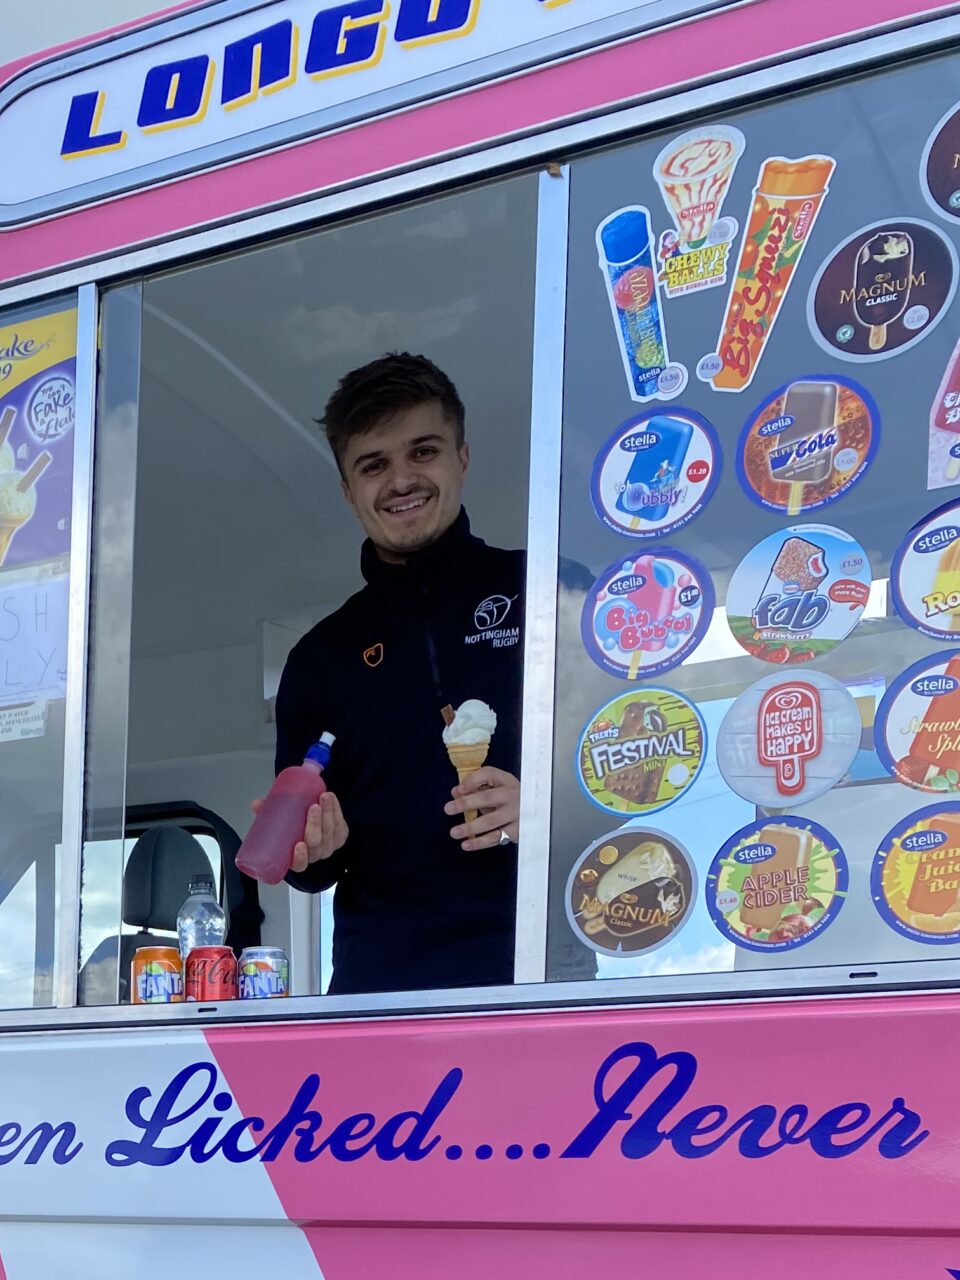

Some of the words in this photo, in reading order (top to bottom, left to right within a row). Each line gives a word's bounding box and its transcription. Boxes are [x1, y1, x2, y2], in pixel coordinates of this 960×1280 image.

[665, 241, 729, 273] CHEWY
[742, 206, 791, 317] Squeezi
[668, 259, 725, 288] BALLS
[840, 271, 927, 305] MAGNUM
[865, 293, 898, 306] CLASSIC
[723, 318, 764, 378] Big
[638, 368, 660, 382] stella
[700, 361, 722, 371] £1.50
[761, 417, 792, 435] stella
[624, 434, 657, 448] stella
[793, 431, 838, 459] Cola
[918, 529, 958, 550] stella
[842, 558, 863, 568] £1.50
[612, 577, 643, 593] stella
[606, 607, 648, 631] Big
[753, 591, 830, 630] fab
[465, 627, 519, 644] NOTTINGHAM
[493, 636, 519, 647] RUGBY
[917, 679, 954, 692] stella
[591, 729, 693, 779] FESTIVAL
[643, 760, 666, 773] MINT
[906, 833, 943, 848] stella
[739, 846, 773, 861] stella
[742, 866, 810, 893] APPLE
[744, 885, 808, 910] CIDER
[579, 893, 670, 928] MAGNUM
[610, 917, 633, 928] Classic
[239, 970, 286, 998] FANTA
[558, 1041, 930, 1160] Never
